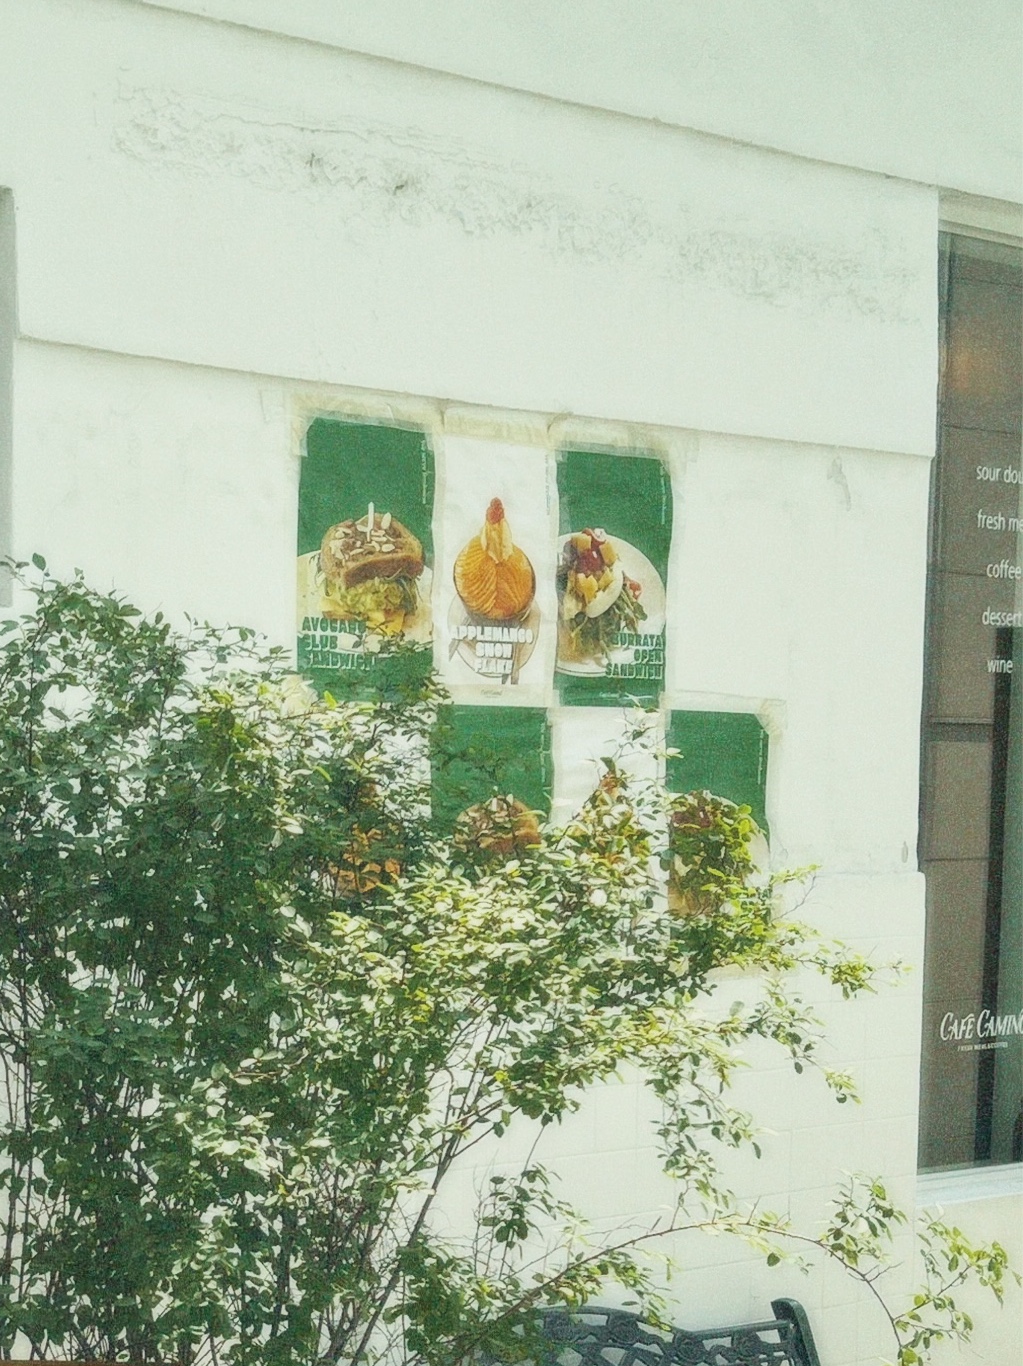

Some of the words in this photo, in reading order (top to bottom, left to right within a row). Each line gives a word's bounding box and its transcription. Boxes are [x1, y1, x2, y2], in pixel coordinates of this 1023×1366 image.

[976, 465, 1001, 481] sour
[977, 508, 1006, 531] fresh
[986, 559, 1022, 579] coffee
[633, 648, 664, 665] OPEN
[987, 655, 1014, 674] wine
